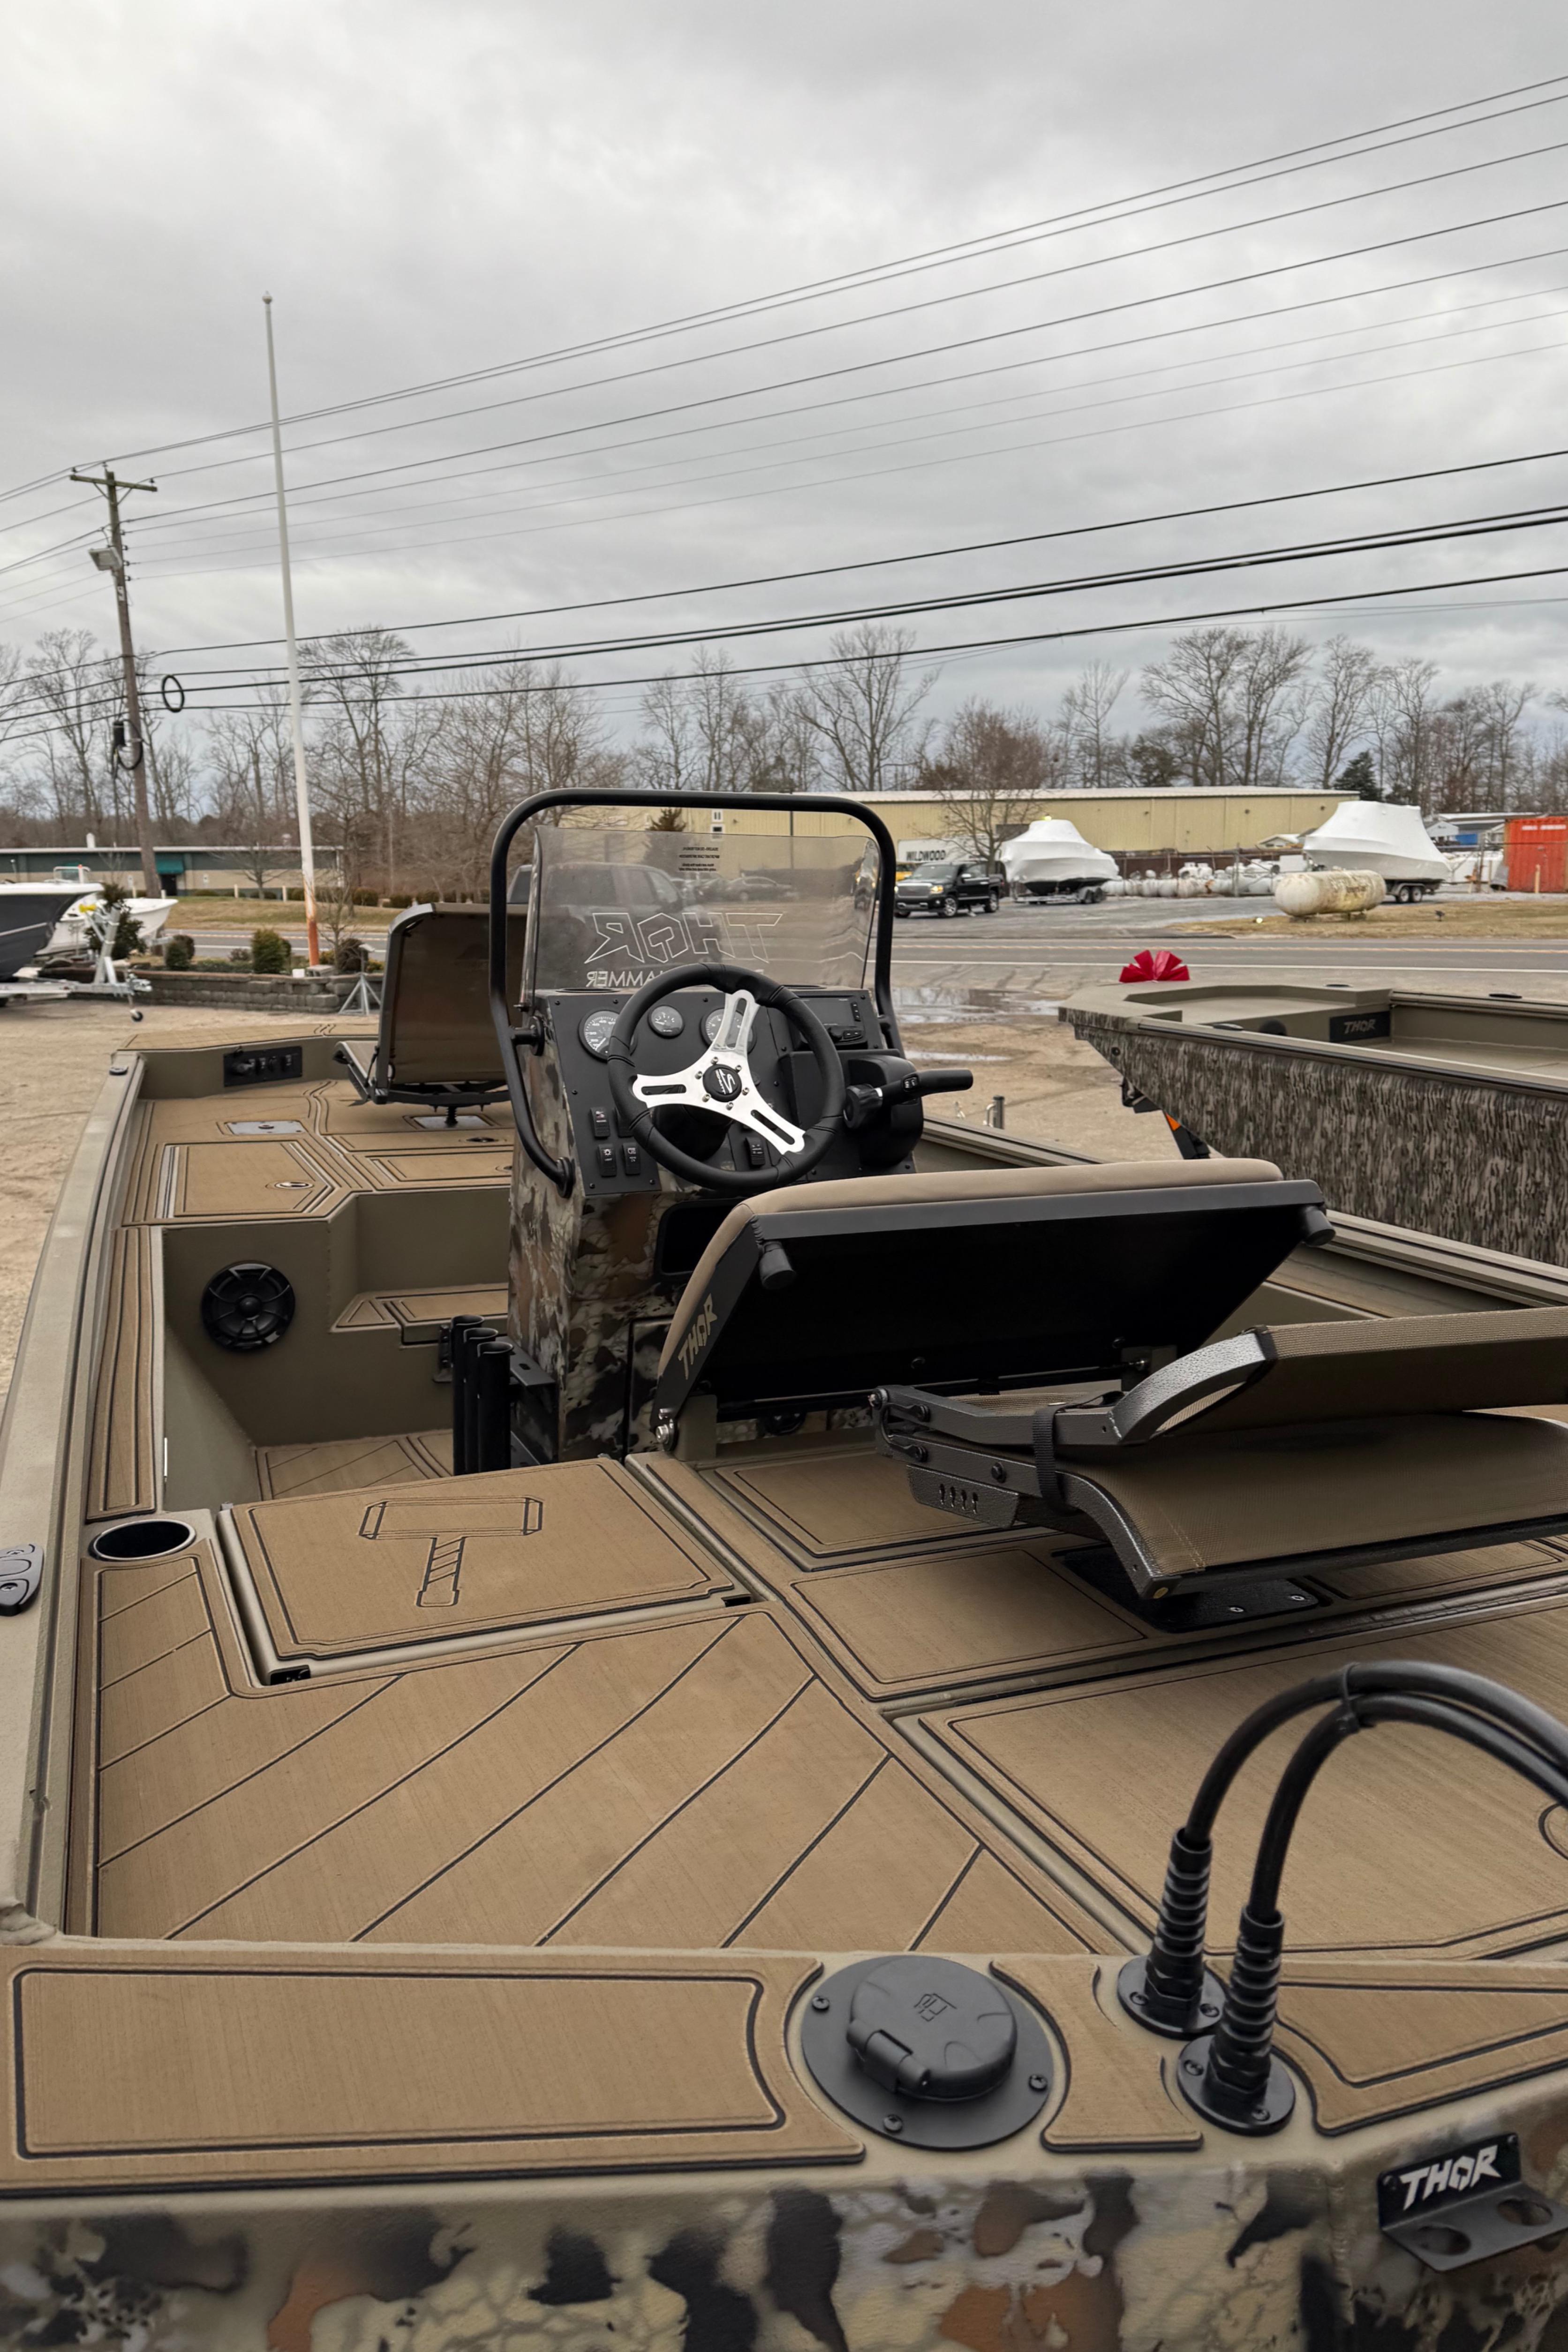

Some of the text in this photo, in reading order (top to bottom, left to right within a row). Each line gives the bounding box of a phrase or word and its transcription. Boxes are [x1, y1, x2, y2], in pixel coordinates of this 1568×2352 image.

[906, 850, 946, 861] WILDWOOD
[1343, 1018, 1377, 1034] THOR
[678, 1293, 718, 1380] THOR
[1399, 2144, 1502, 2211] THOR
